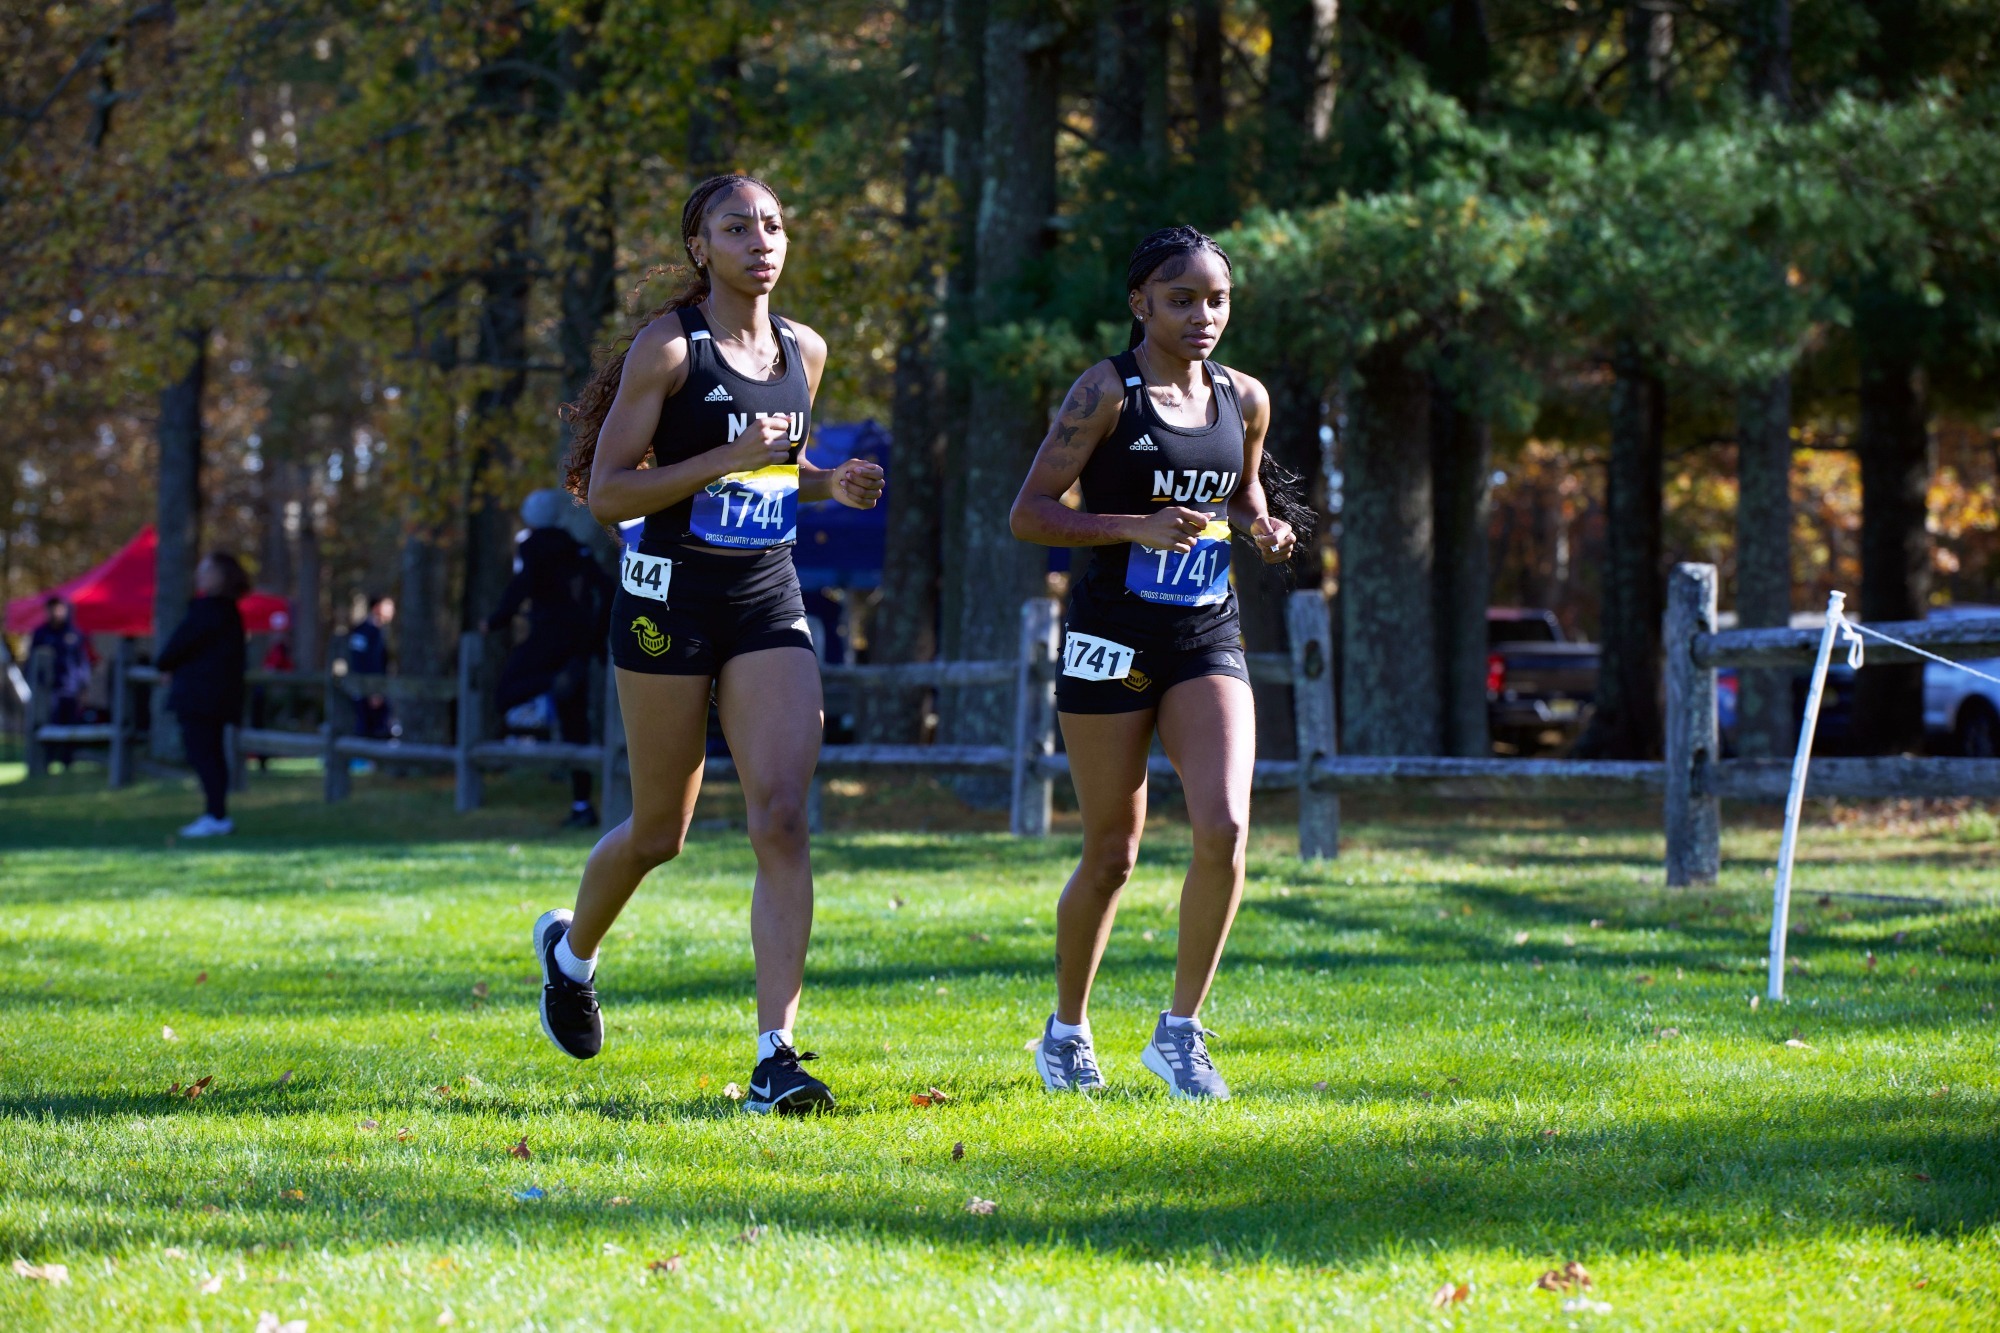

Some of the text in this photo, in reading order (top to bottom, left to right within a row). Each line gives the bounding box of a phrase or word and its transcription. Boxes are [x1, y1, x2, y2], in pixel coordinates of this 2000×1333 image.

[704, 393, 733, 402] adidas
[727, 412, 804, 443] NU
[1129, 443, 1159, 451] adidas
[1152, 469, 1237, 503] NJCU
[718, 490, 784, 530] 1744
[705, 533, 723, 543] CROSS
[723, 534, 749, 545] COUNTRY
[1154, 549, 1218, 587] 1741
[1140, 590, 1159, 600] CROSS
[1159, 592, 1184, 602] COUNTRY
[1067, 639, 1121, 677] 1741
